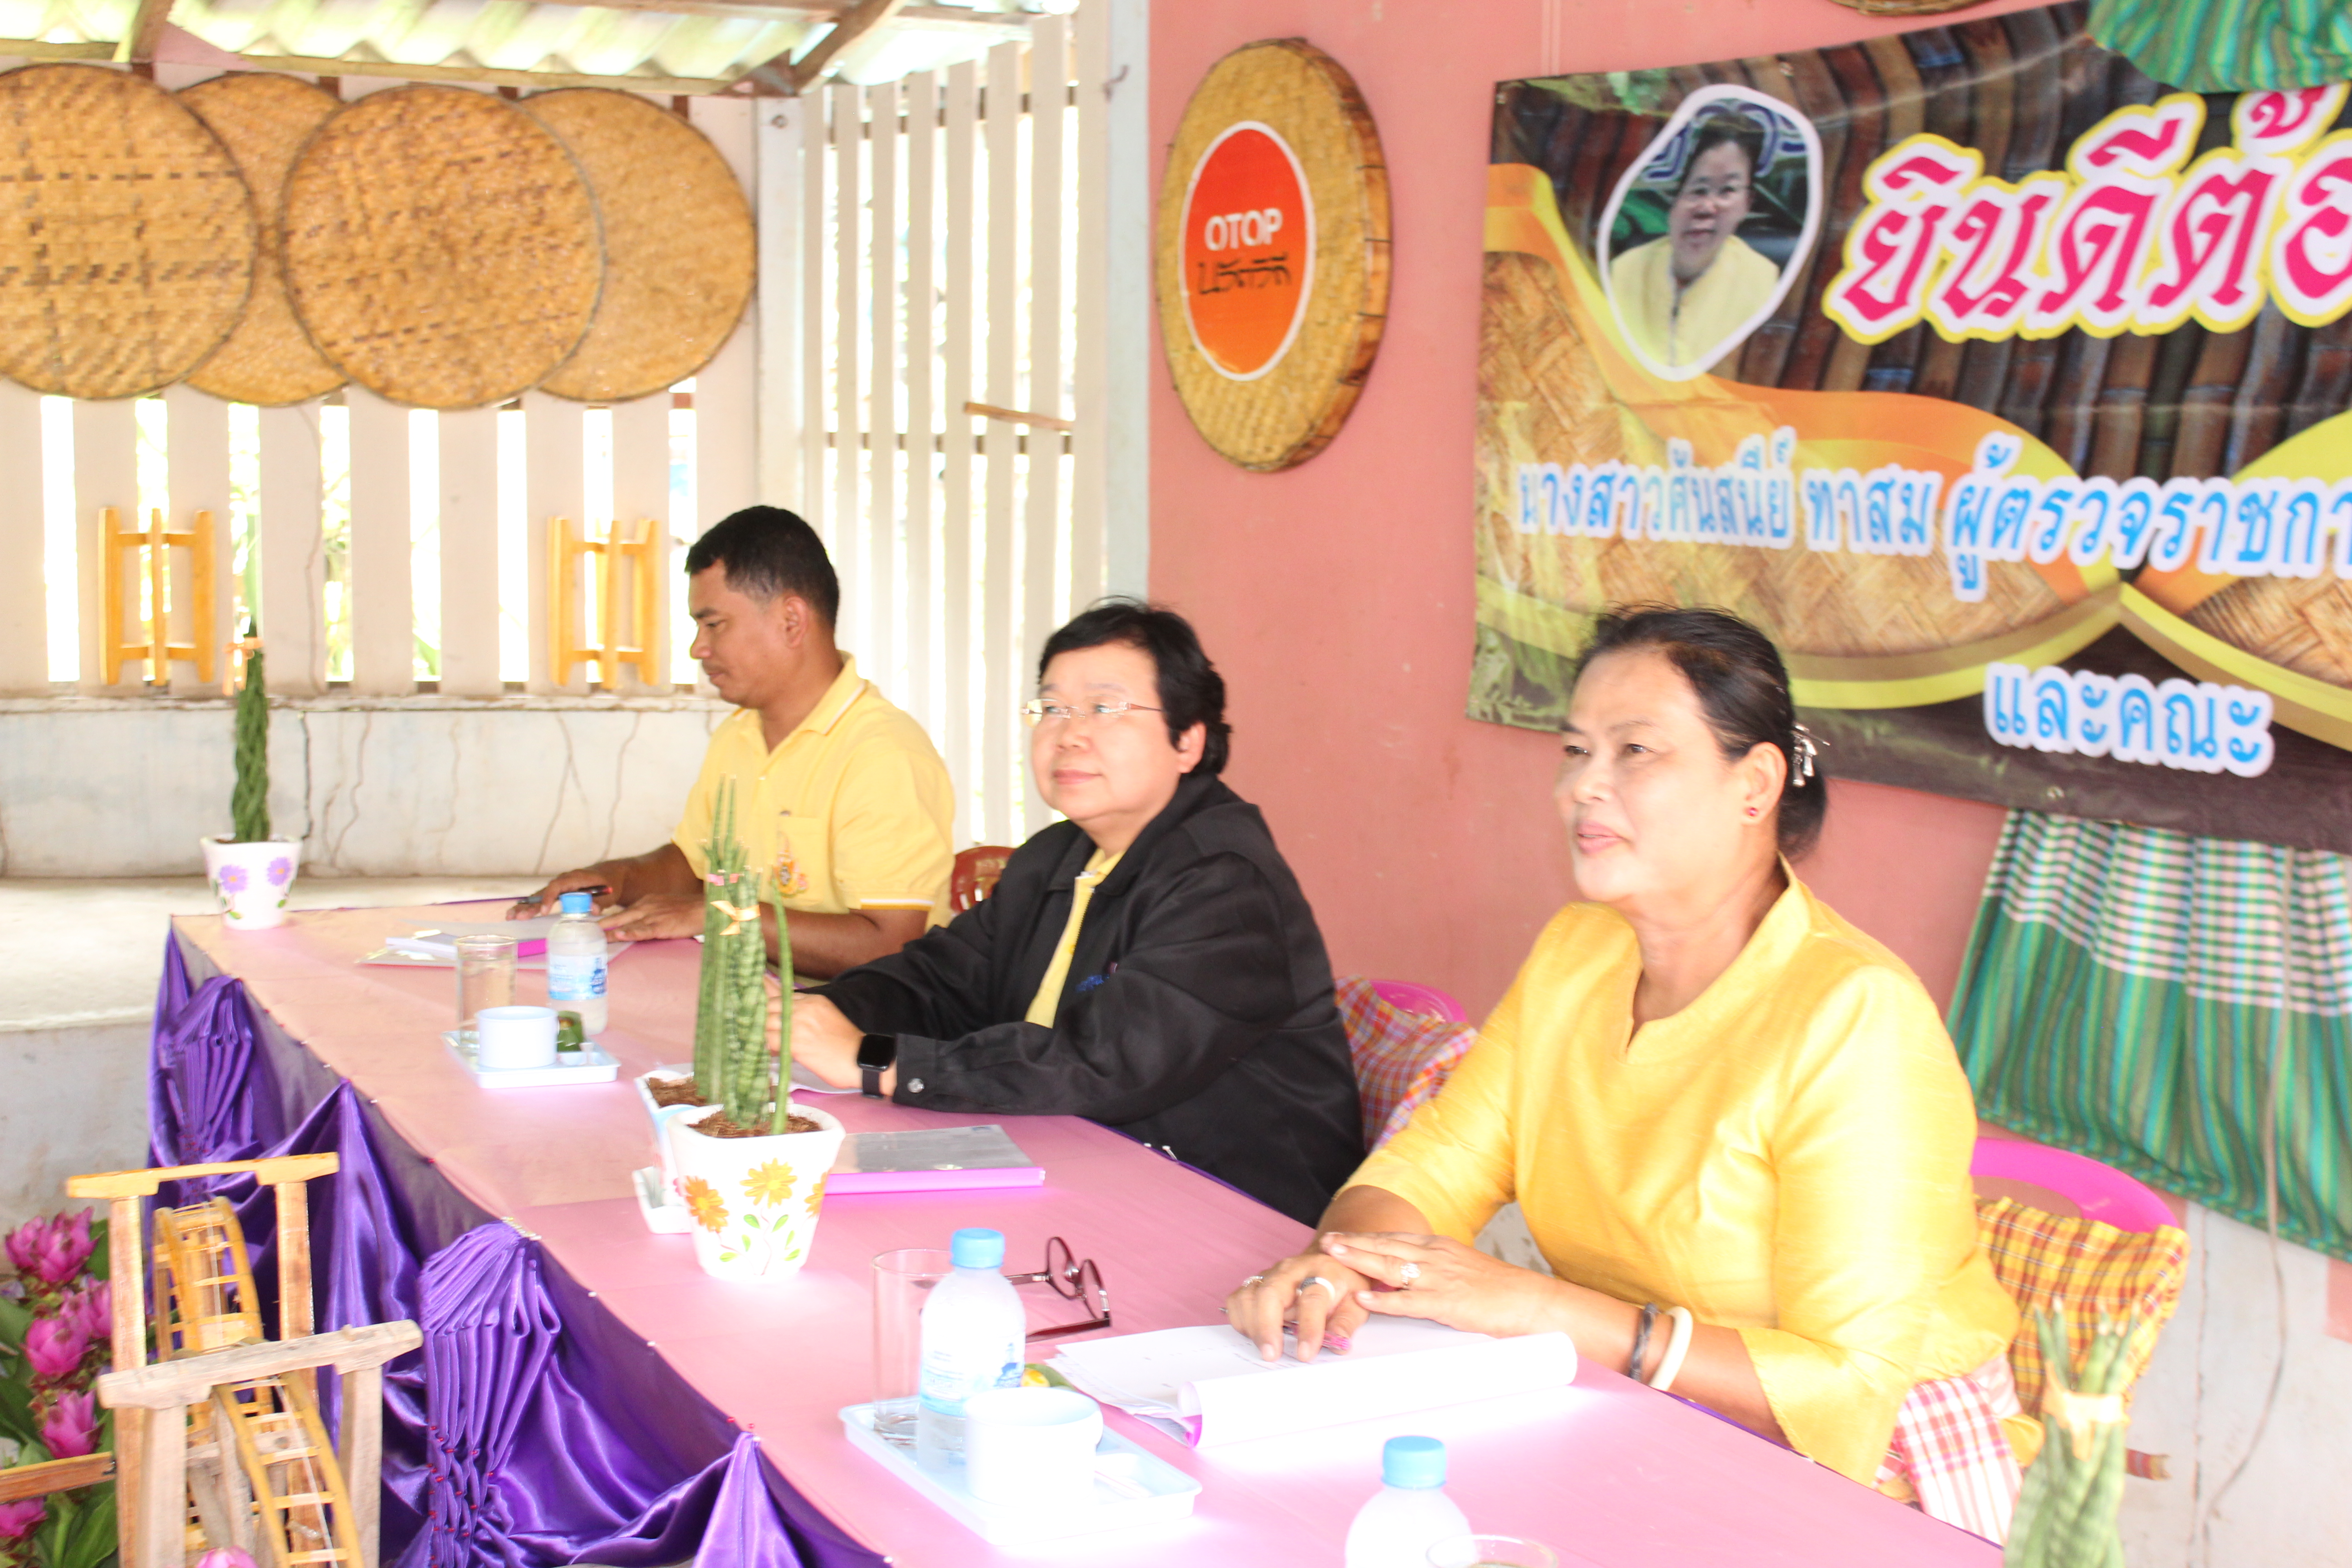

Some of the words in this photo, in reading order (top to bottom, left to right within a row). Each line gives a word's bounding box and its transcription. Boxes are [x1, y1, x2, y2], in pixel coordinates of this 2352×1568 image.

[1204, 207, 1284, 251] OTOP
[1808, 476, 1935, 545] ทาสม
[1994, 675, 2263, 763] และคณะ
